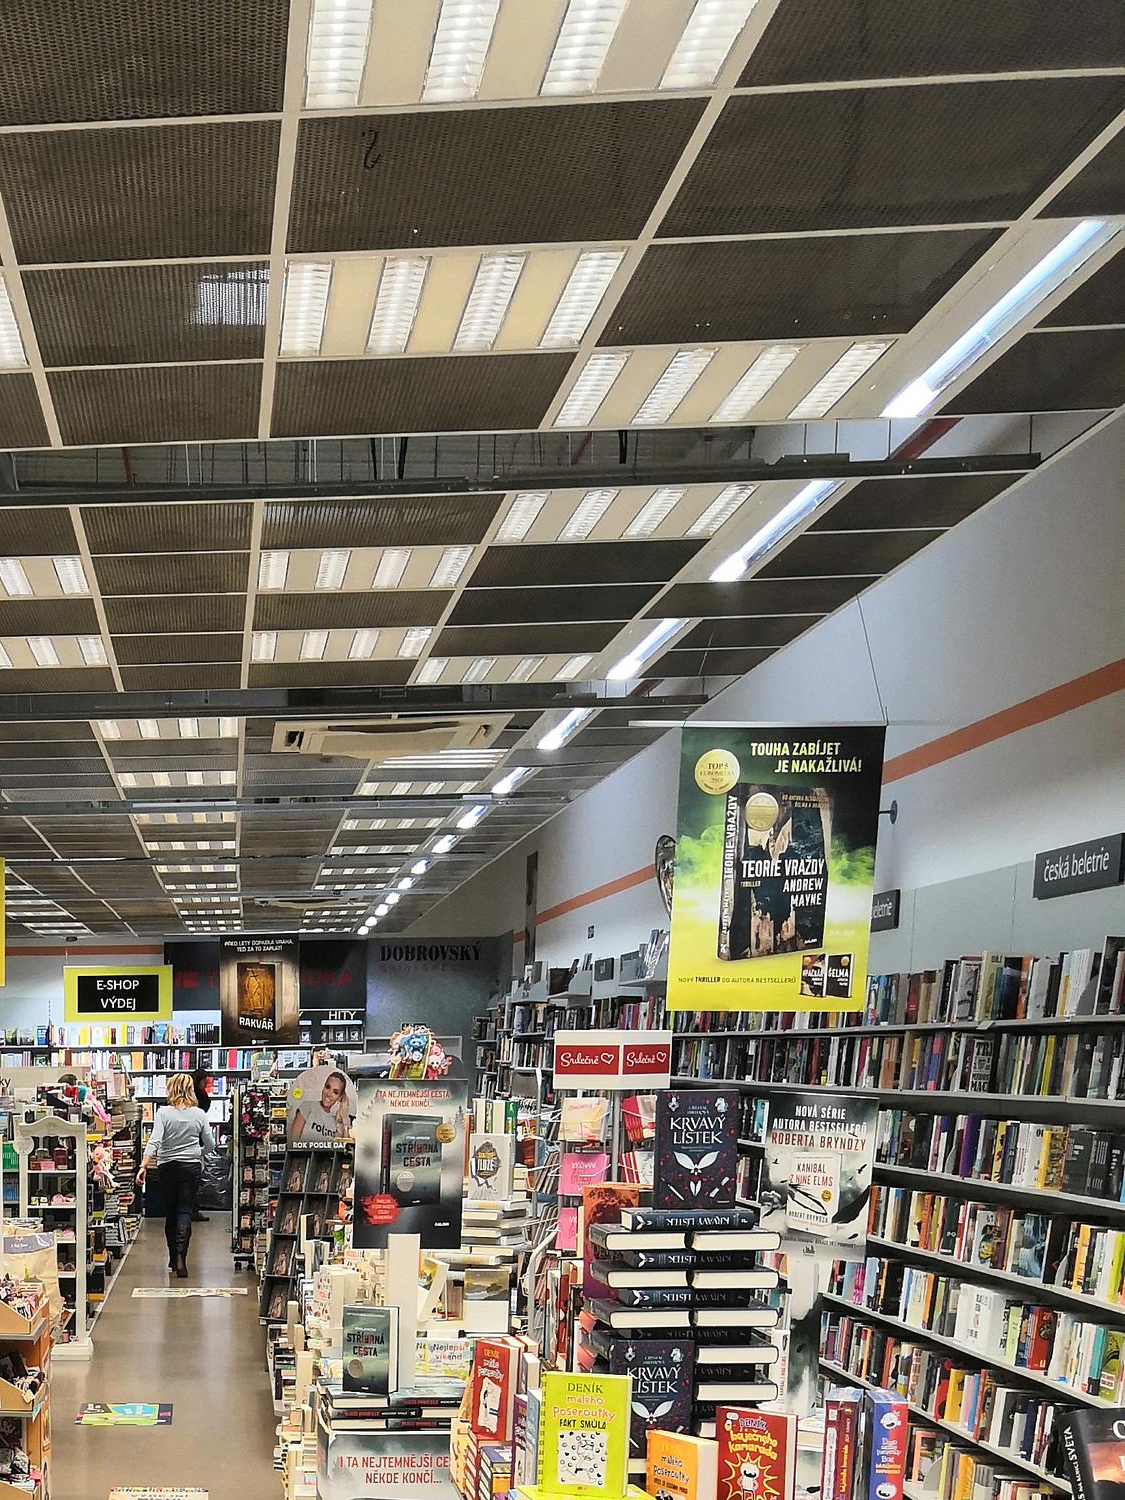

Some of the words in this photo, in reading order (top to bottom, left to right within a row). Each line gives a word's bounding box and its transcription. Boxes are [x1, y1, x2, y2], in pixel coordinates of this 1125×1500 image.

[751, 743, 789, 756] TOUHA
[792, 739, 841, 756] ZABÍJET
[775, 760, 789, 773] JE
[791, 757, 862, 772] NAKAŽLIVÁ!
[742, 859, 781, 877] TEORIE
[785, 855, 824, 877] VRAŽDY
[1044, 858, 1069, 882] česká
[1072, 847, 1109, 875] beletrie
[783, 878, 823, 892] ANDREW
[791, 893, 822, 907] MAYNE
[380, 940, 483, 961] DOBROVSKÝ
[97, 980, 139, 990] E-SHOP
[101, 996, 136, 1010] VÝDEJ
[329, 1010, 355, 1020] HITY
[239, 1017, 274, 1030] RAKVÁŘ
[387, 1089, 430, 1098] NEJTEMNĚJŠÍ
[431, 1090, 451, 1098] CESTA
[795, 1104, 819, 1118] NOVÁ
[821, 1105, 846, 1119] SÉRIE
[670, 1115, 726, 1130] KRVAVÝ
[773, 1119, 807, 1131] AUTORA
[809, 1120, 867, 1134] BESTSELLERŮ
[673, 1129, 722, 1144] LÍSTEK
[772, 1134, 815, 1147] ROBERTA
[819, 1136, 866, 1151] BRYNDZY
[396, 1140, 439, 1153] STŘÍBRNÁ
[403, 1156, 431, 1167] CESTA
[797, 1163, 826, 1173] KANIBAL
[796, 1175, 812, 1185] NINE
[815, 1175, 833, 1186] ELMS
[347, 1332, 385, 1345] STŘÍBRNÁ
[353, 1346, 378, 1357] CESTA
[567, 1381, 603, 1394] DENÍK
[559, 1418, 577, 1428] FAKT
[580, 1418, 607, 1429] SMŮLA
[347, 1456, 359, 1468] TA
[362, 1454, 433, 1468] NEJTEMNĚJŠÍ
